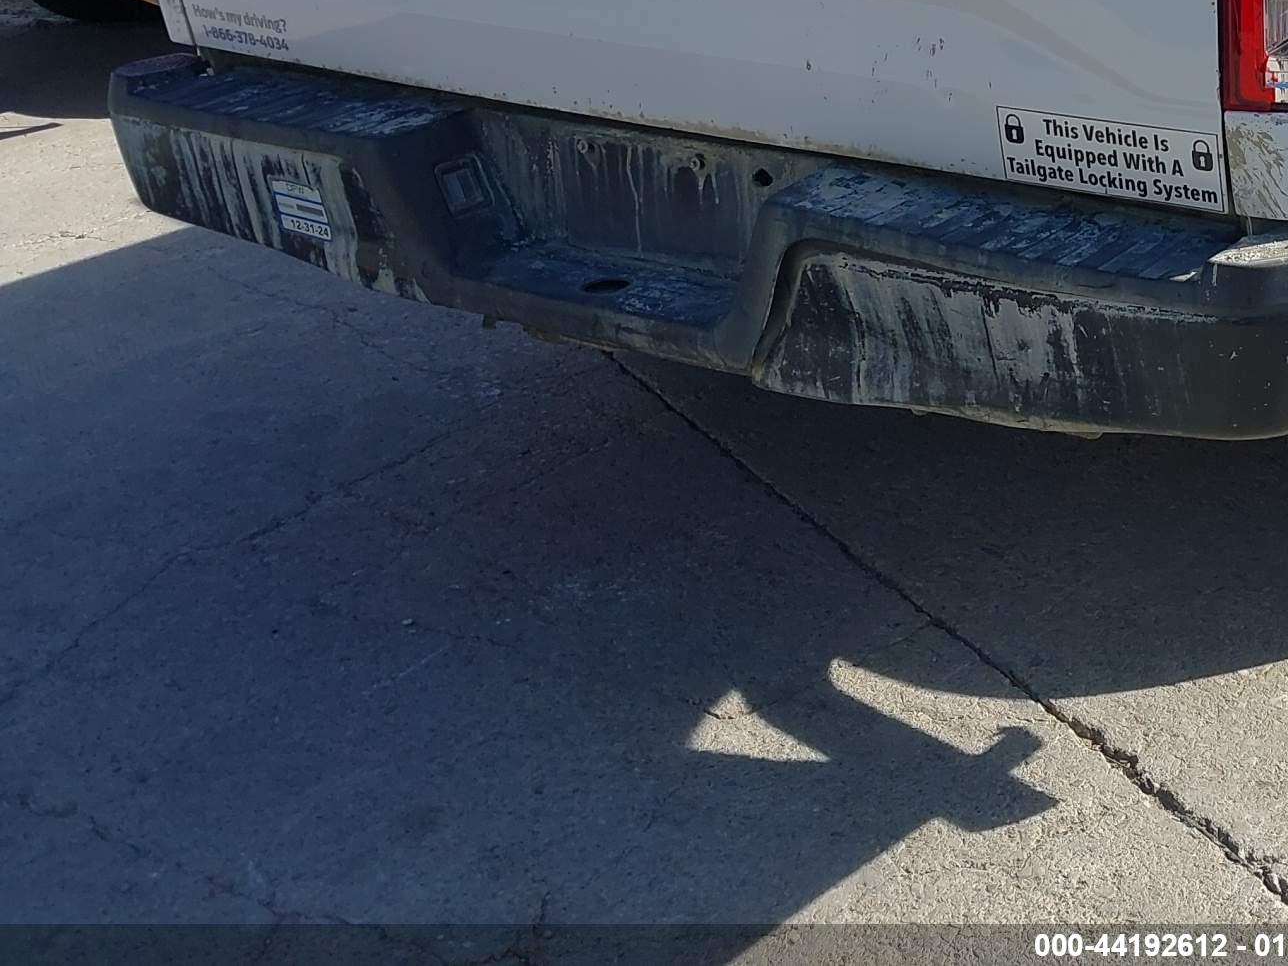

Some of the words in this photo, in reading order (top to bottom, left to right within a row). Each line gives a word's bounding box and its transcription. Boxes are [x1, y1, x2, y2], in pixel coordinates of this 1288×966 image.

[192, 3, 225, 21] How's
[225, 11, 242, 26] my
[243, 12, 287, 34] driving?
[1043, 119, 1078, 139] This
[1083, 124, 1148, 149] Vehicle
[1154, 134, 1169, 152] Is
[1035, 139, 1118, 168] Equipped
[1123, 152, 1167, 175] With
[1172, 159, 1184, 177] A
[1007, 157, 1074, 182] Tailgate
[1079, 168, 1148, 197] Locking
[1153, 179, 1218, 204] System
